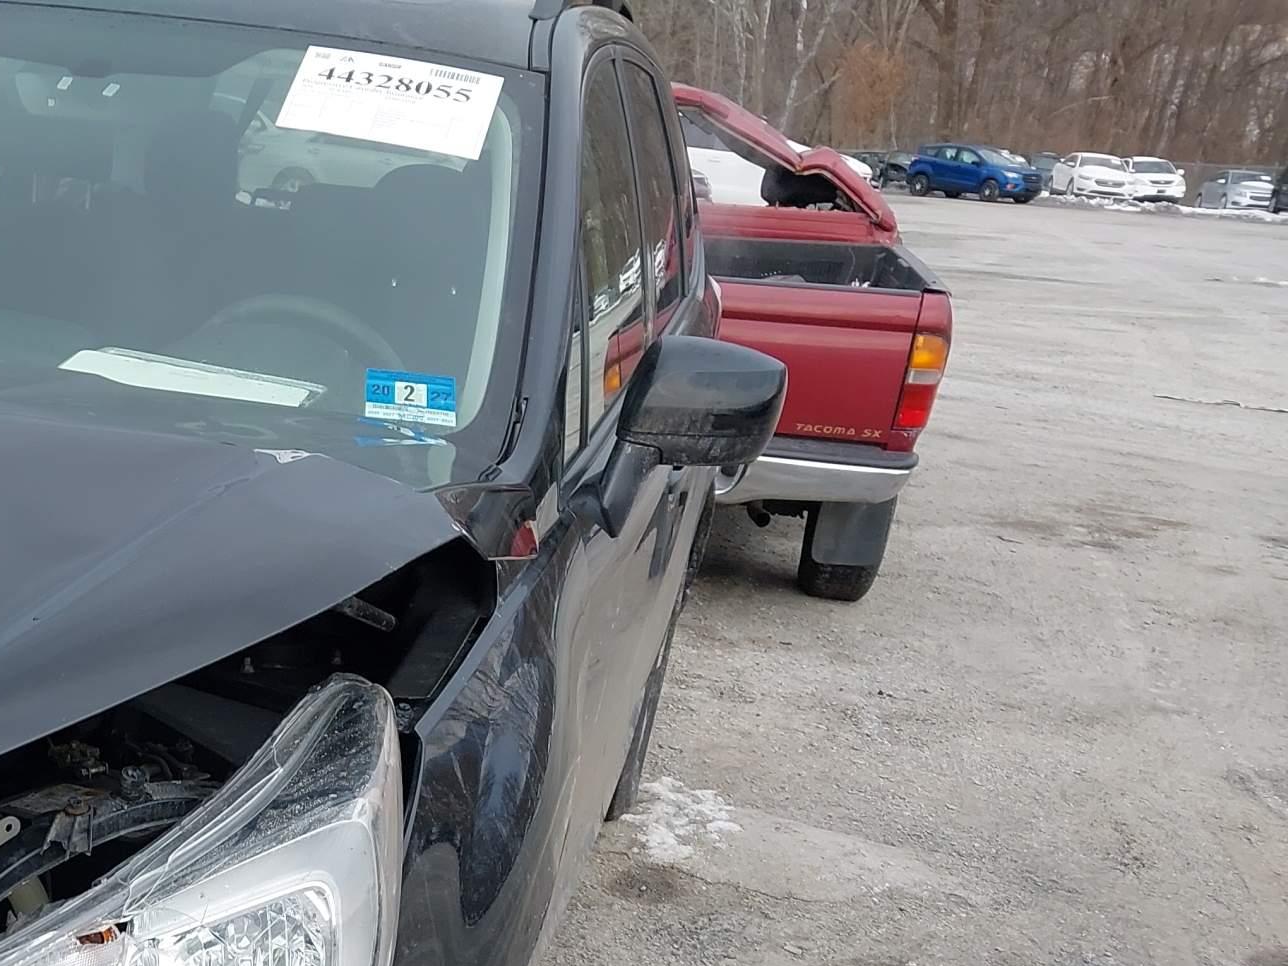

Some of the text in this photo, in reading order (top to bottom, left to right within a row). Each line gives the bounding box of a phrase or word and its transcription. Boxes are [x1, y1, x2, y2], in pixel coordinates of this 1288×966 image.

[317, 66, 473, 103] 44328055
[403, 384, 416, 402] 2
[795, 423, 883, 438] TACOMA SX
